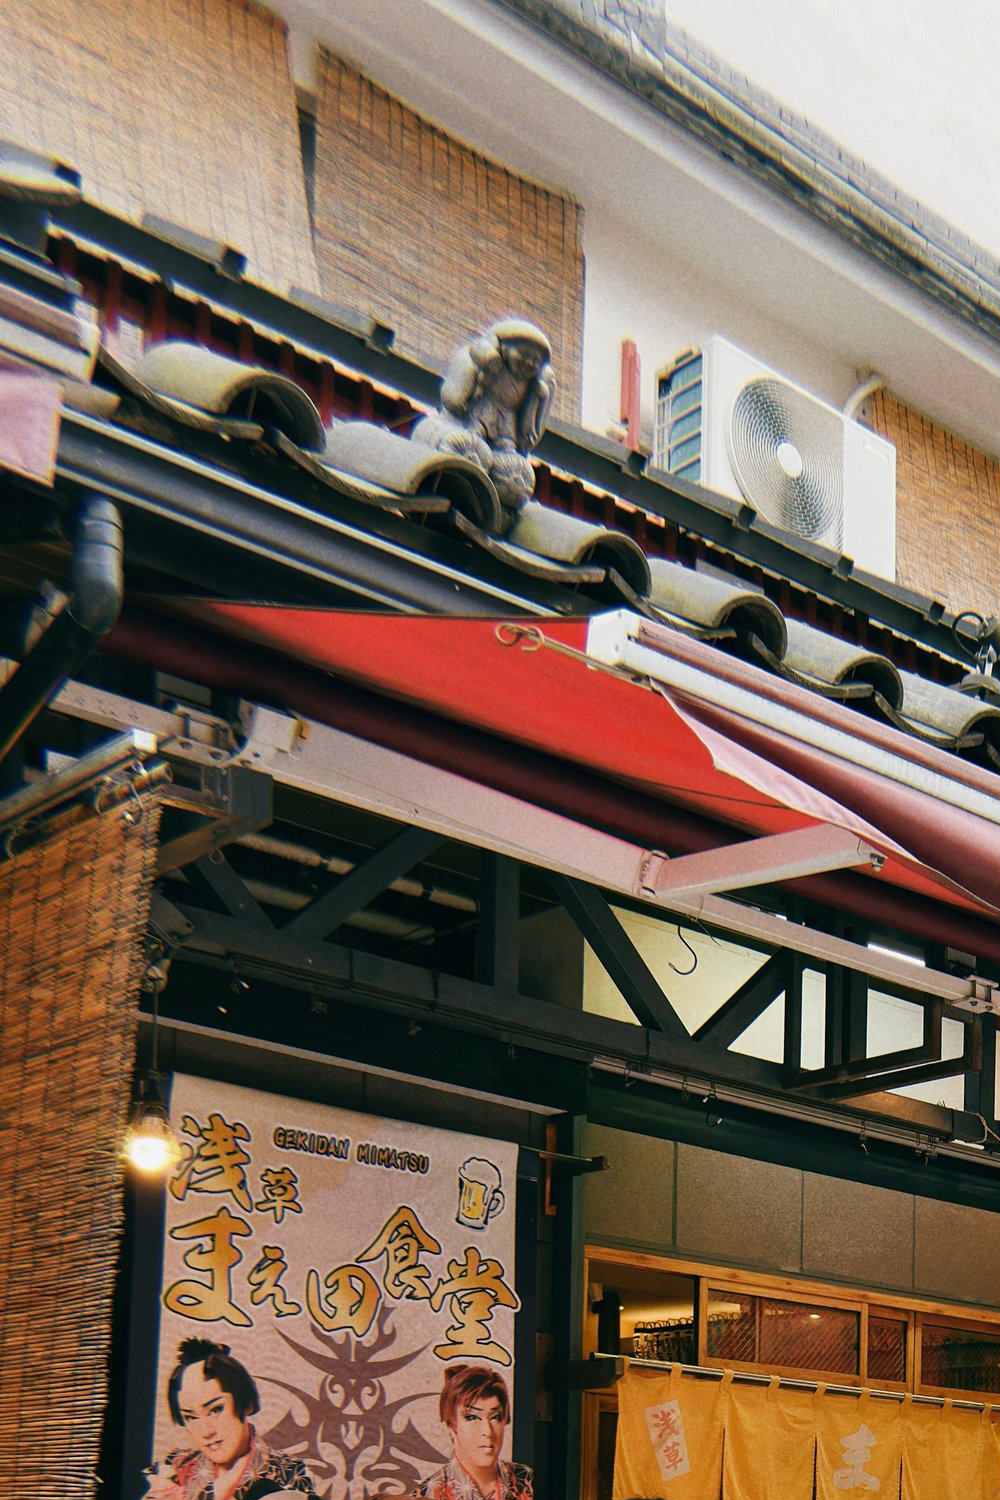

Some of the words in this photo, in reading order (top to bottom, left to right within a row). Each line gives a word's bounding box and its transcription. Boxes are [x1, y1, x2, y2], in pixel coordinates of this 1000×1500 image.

[168, 1112, 303, 1224] 浅草
[273, 1126, 349, 1159] GEKIDAN
[357, 1143, 431, 1175] MIMATSU
[651, 1408, 684, 1471] 浅草
